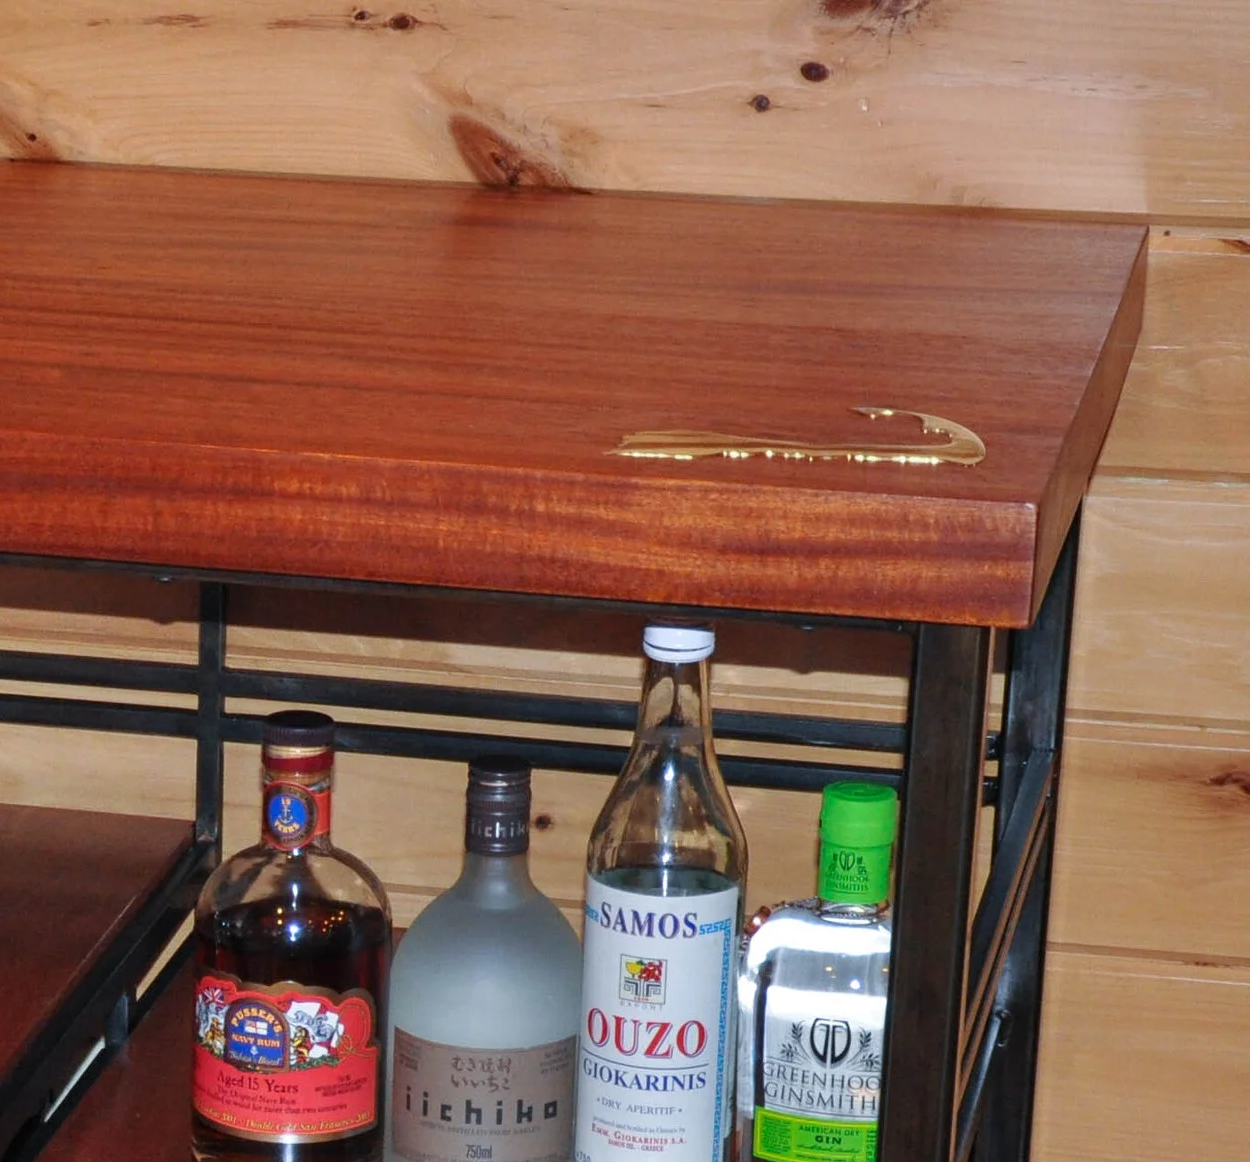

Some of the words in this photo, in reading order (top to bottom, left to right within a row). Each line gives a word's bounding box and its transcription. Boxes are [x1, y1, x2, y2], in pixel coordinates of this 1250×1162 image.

[470, 818, 527, 839] iichik
[599, 900, 699, 940] SAMOS
[231, 1007, 283, 1034] PUSSER'S
[587, 1007, 708, 1060] OUZO
[231, 1033, 255, 1045] NAVY
[256, 1037, 281, 1049] RUM
[216, 1069, 245, 1089] Aged
[248, 1075, 260, 1092] 15
[264, 1078, 300, 1094] Years
[582, 1057, 707, 1092] GIOKARINIS
[762, 1062, 881, 1092] GREENHOO
[405, 1085, 558, 1126] iichiko
[601, 1097, 622, 1111] DRY
[626, 1104, 676, 1117] APERITIF
[764, 1080, 877, 1112] GINSMITH
[798, 1124, 842, 1136] AMERICAN
[814, 1135, 842, 1145] GIN
[465, 1144, 493, 1160] 750ml
